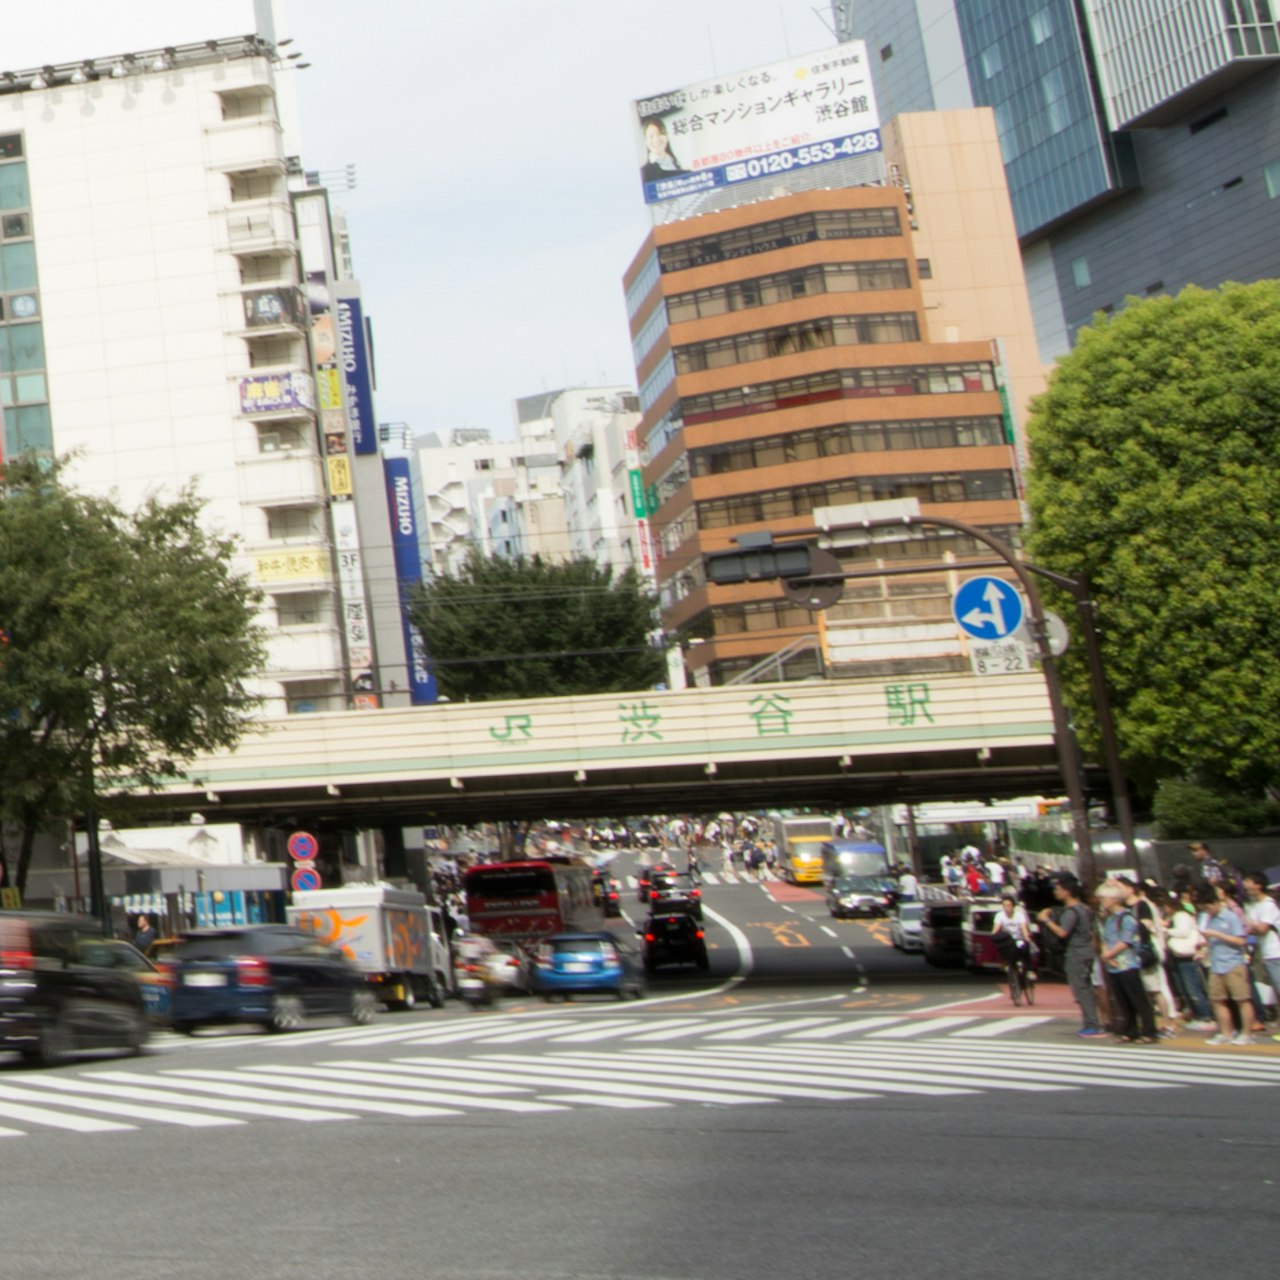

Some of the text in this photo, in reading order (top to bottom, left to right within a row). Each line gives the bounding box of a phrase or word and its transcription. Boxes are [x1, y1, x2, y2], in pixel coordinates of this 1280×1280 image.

[672, 77, 865, 136] 総合マンションギャラリー
[815, 95, 869, 123] 渋谷館
[748, 132, 880, 177] 0120-553-428
[791, 233, 808, 245] 11F
[339, 310, 357, 372] MIZUHO
[394, 476, 414, 536] MIZUHO
[341, 554, 358, 568] 3F
[490, 682, 936, 743] JR 渋谷駅
